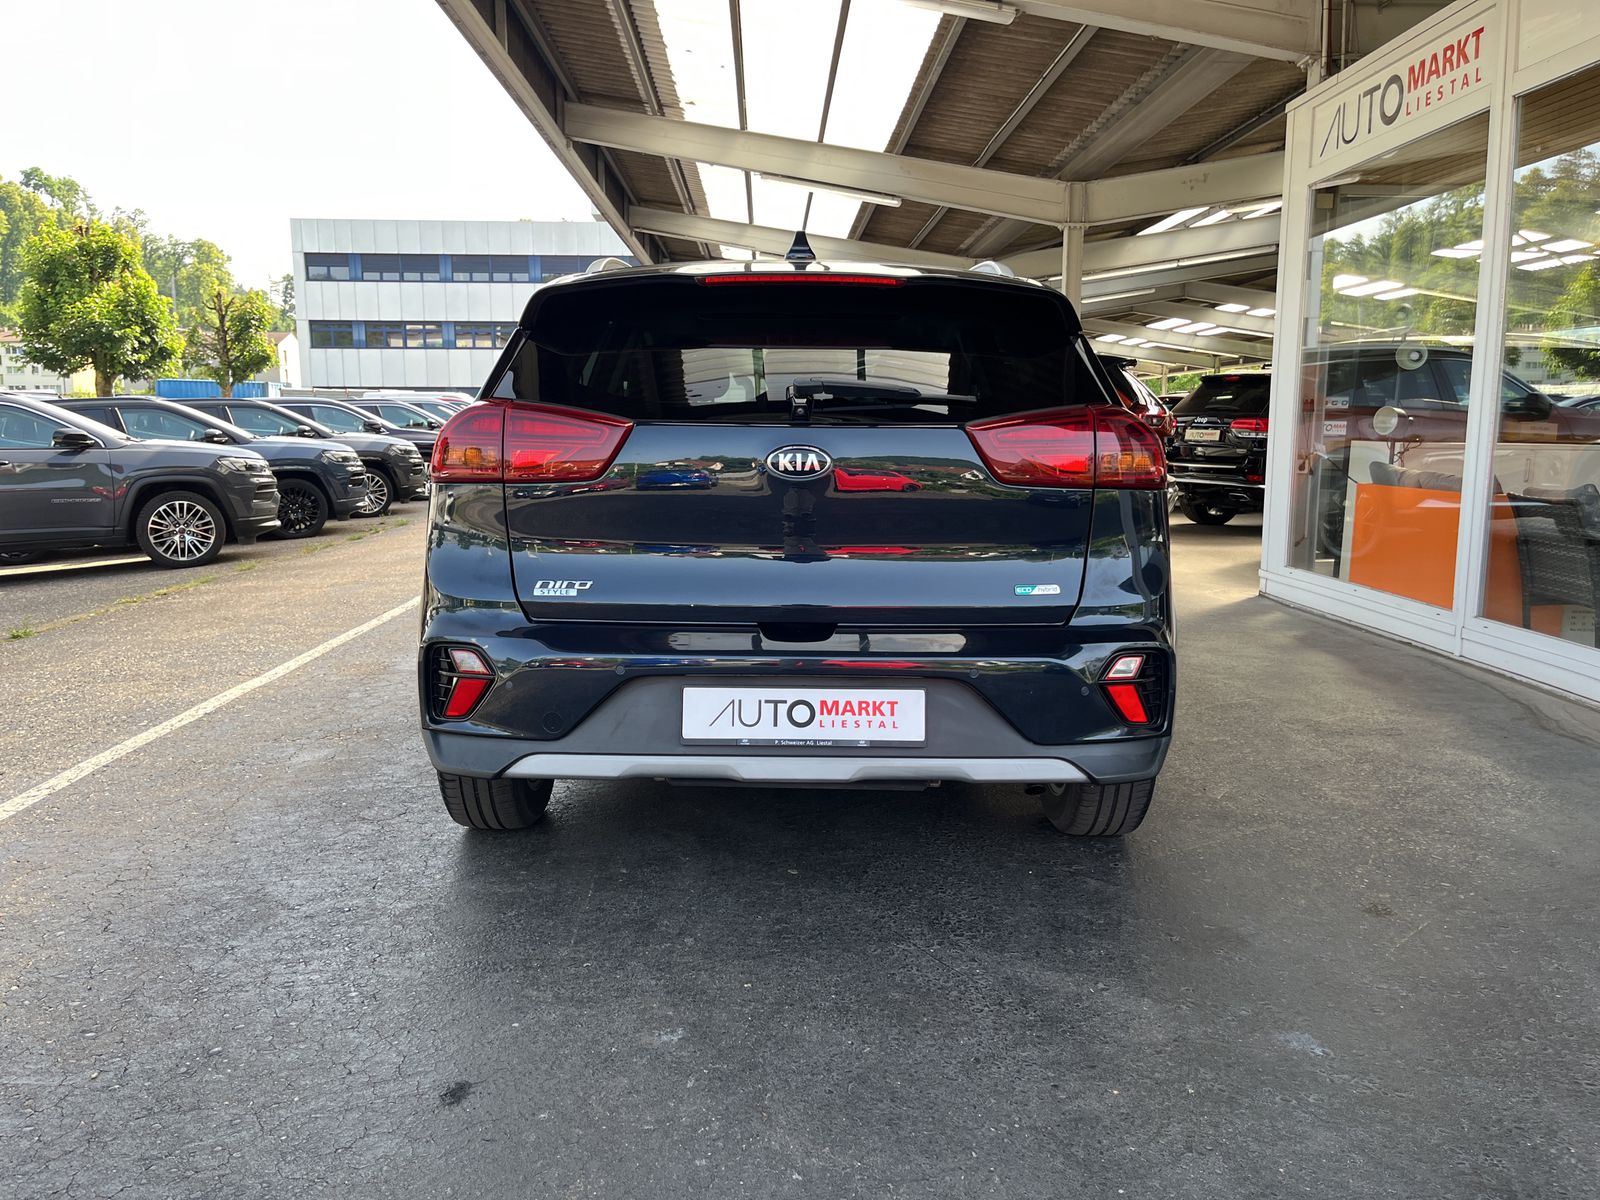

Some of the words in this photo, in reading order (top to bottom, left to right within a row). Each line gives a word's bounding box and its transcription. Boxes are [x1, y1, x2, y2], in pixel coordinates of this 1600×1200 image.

[1319, 74, 1404, 158] AUTO
[1406, 26, 1485, 94] MARKT
[1405, 67, 1482, 116] LIESTAL
[778, 453, 821, 472] KIA
[709, 698, 816, 728] AUTO
[819, 700, 899, 717] MARKT
[819, 719, 899, 729] LIESTAL
